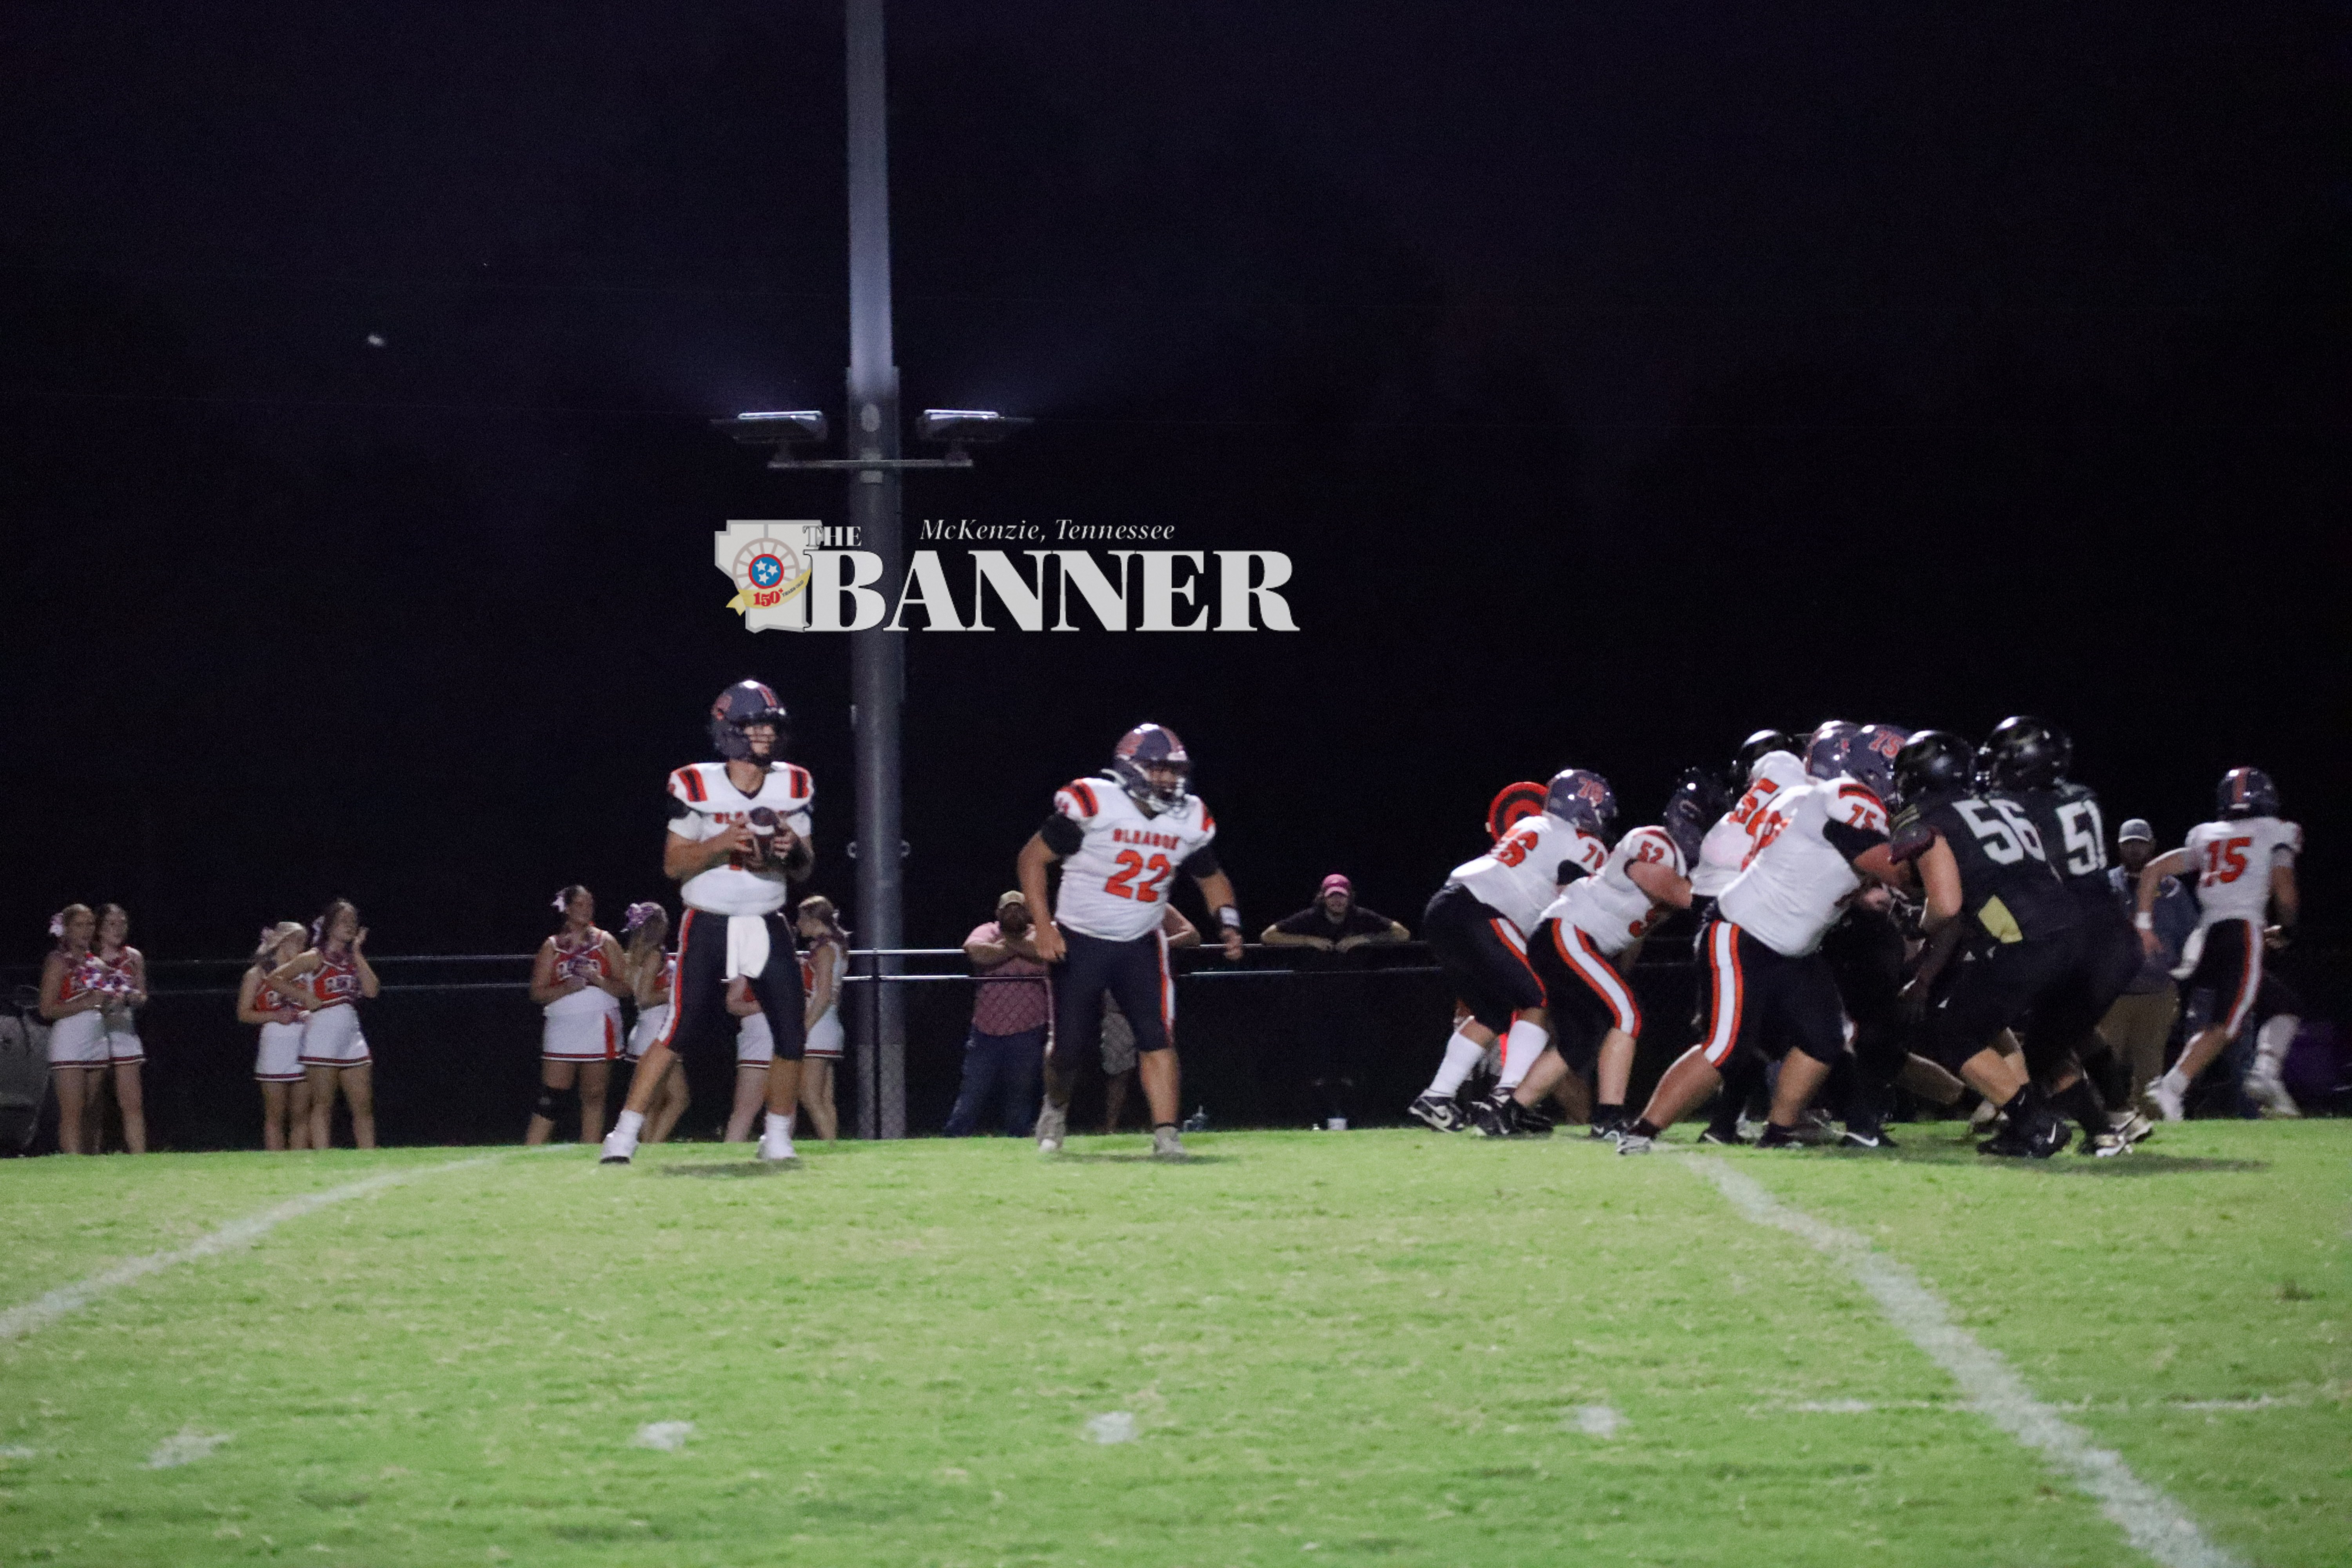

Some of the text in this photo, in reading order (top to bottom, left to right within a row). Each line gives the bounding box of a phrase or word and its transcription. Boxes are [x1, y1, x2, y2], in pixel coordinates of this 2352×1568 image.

[1952, 799, 2046, 865] 56
[2055, 800, 2107, 875] 51
[1104, 849, 1171, 902] 22
[2204, 837, 2252, 887] 15
